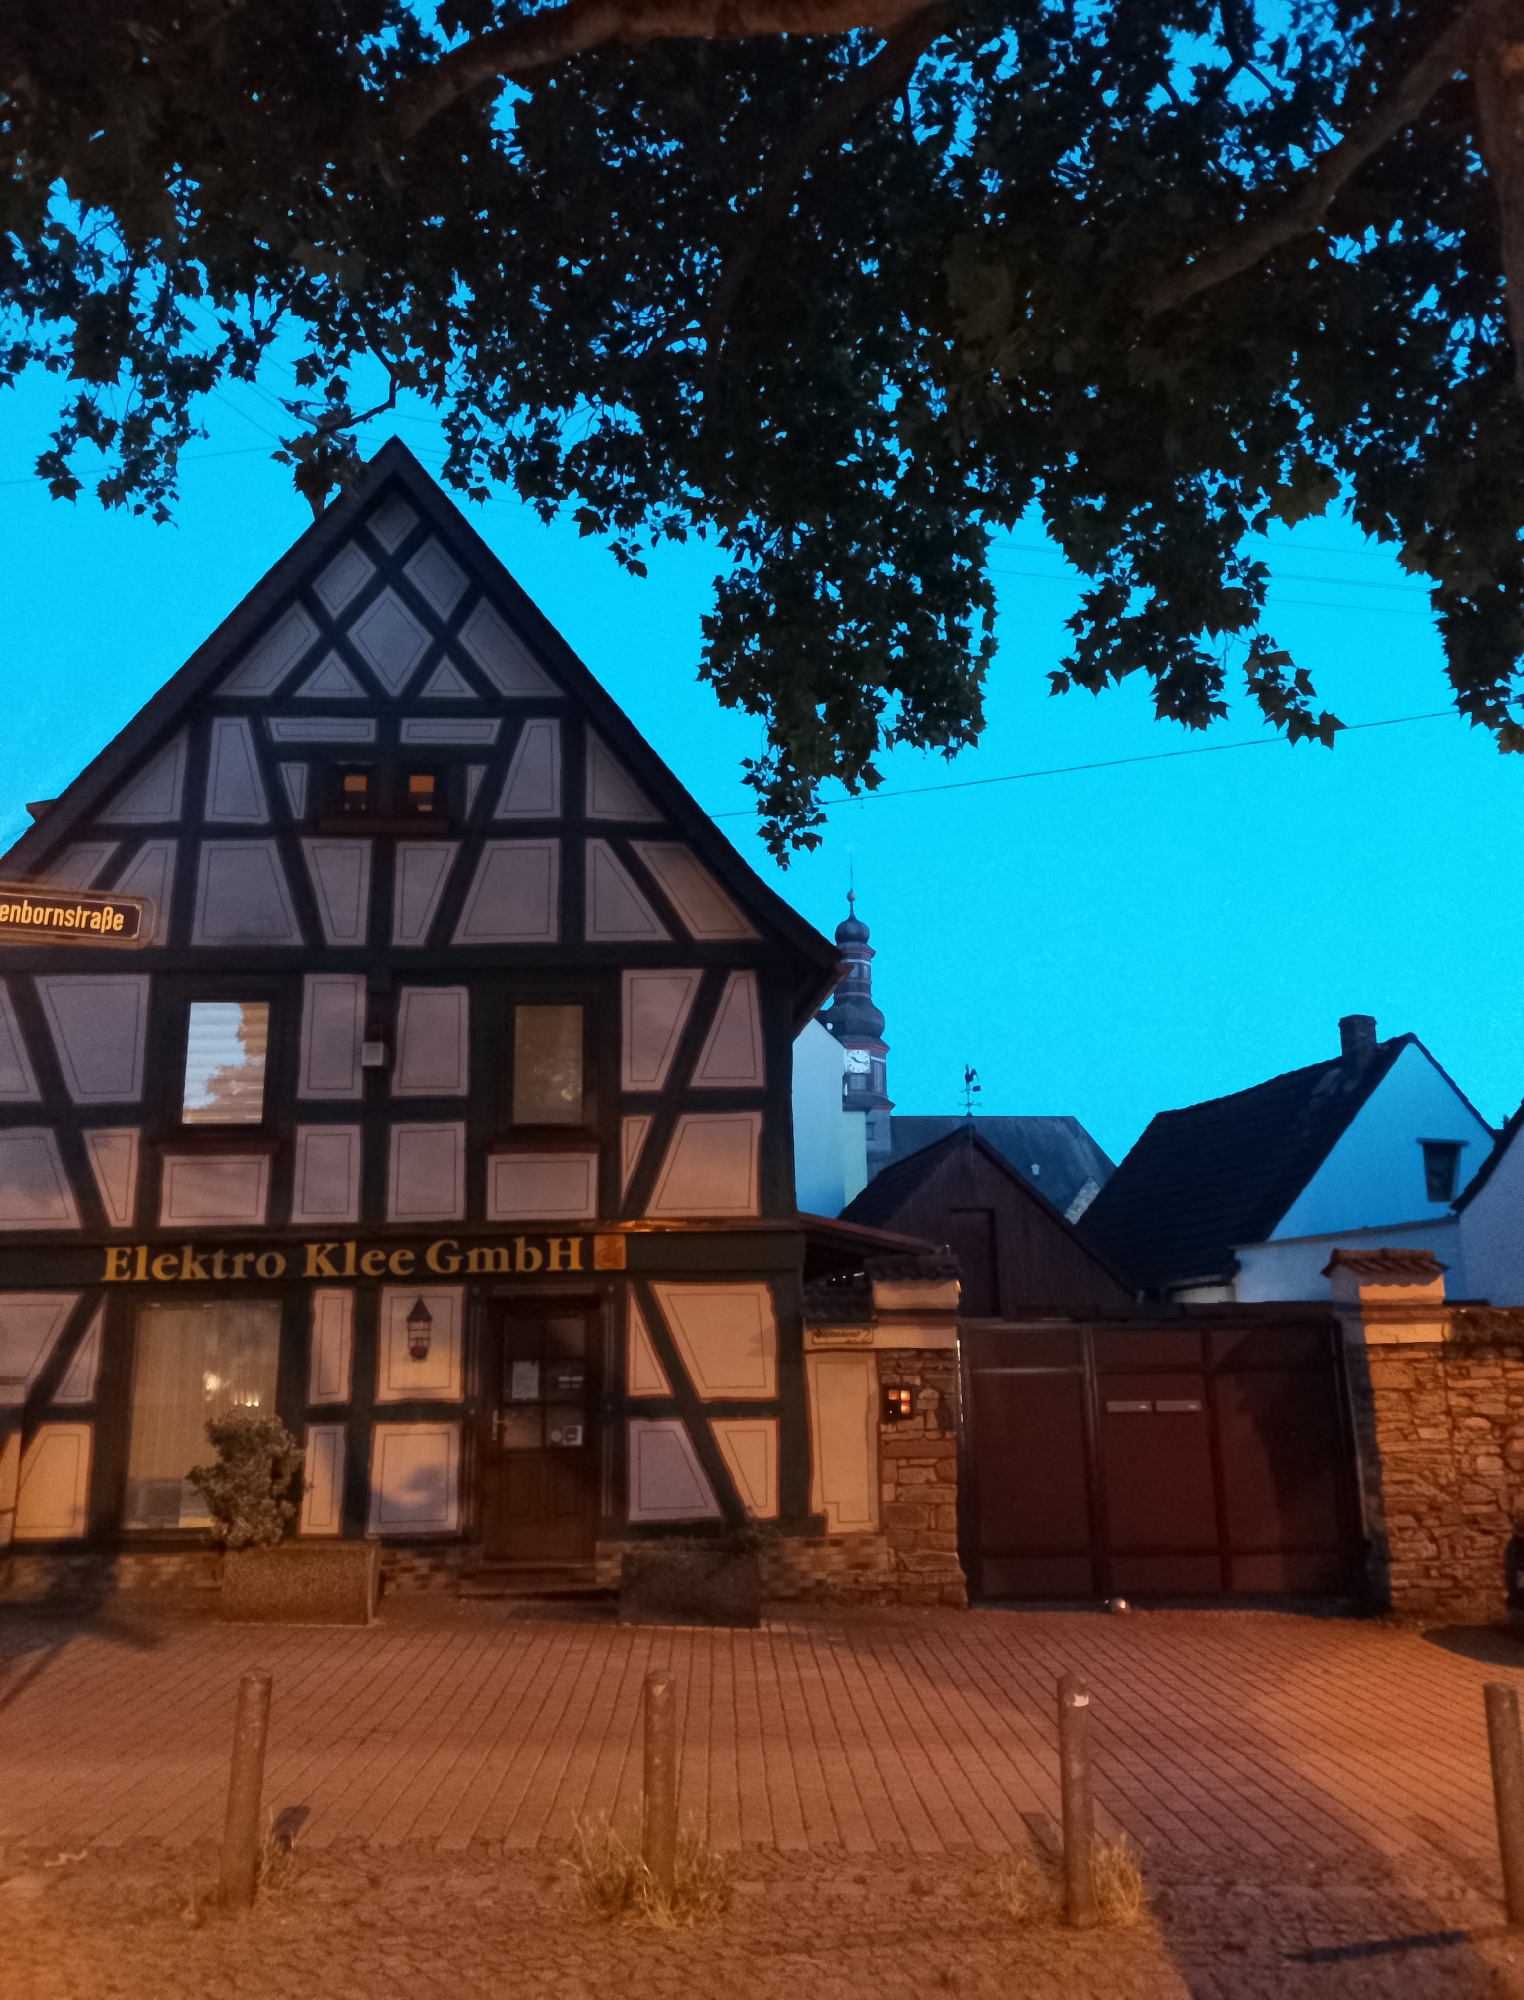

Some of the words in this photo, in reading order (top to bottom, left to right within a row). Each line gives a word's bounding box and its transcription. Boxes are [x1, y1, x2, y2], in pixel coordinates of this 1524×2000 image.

[101, 1244, 287, 1281] Elektro
[302, 1240, 415, 1277] Klee
[425, 1237, 583, 1274] GmbH
